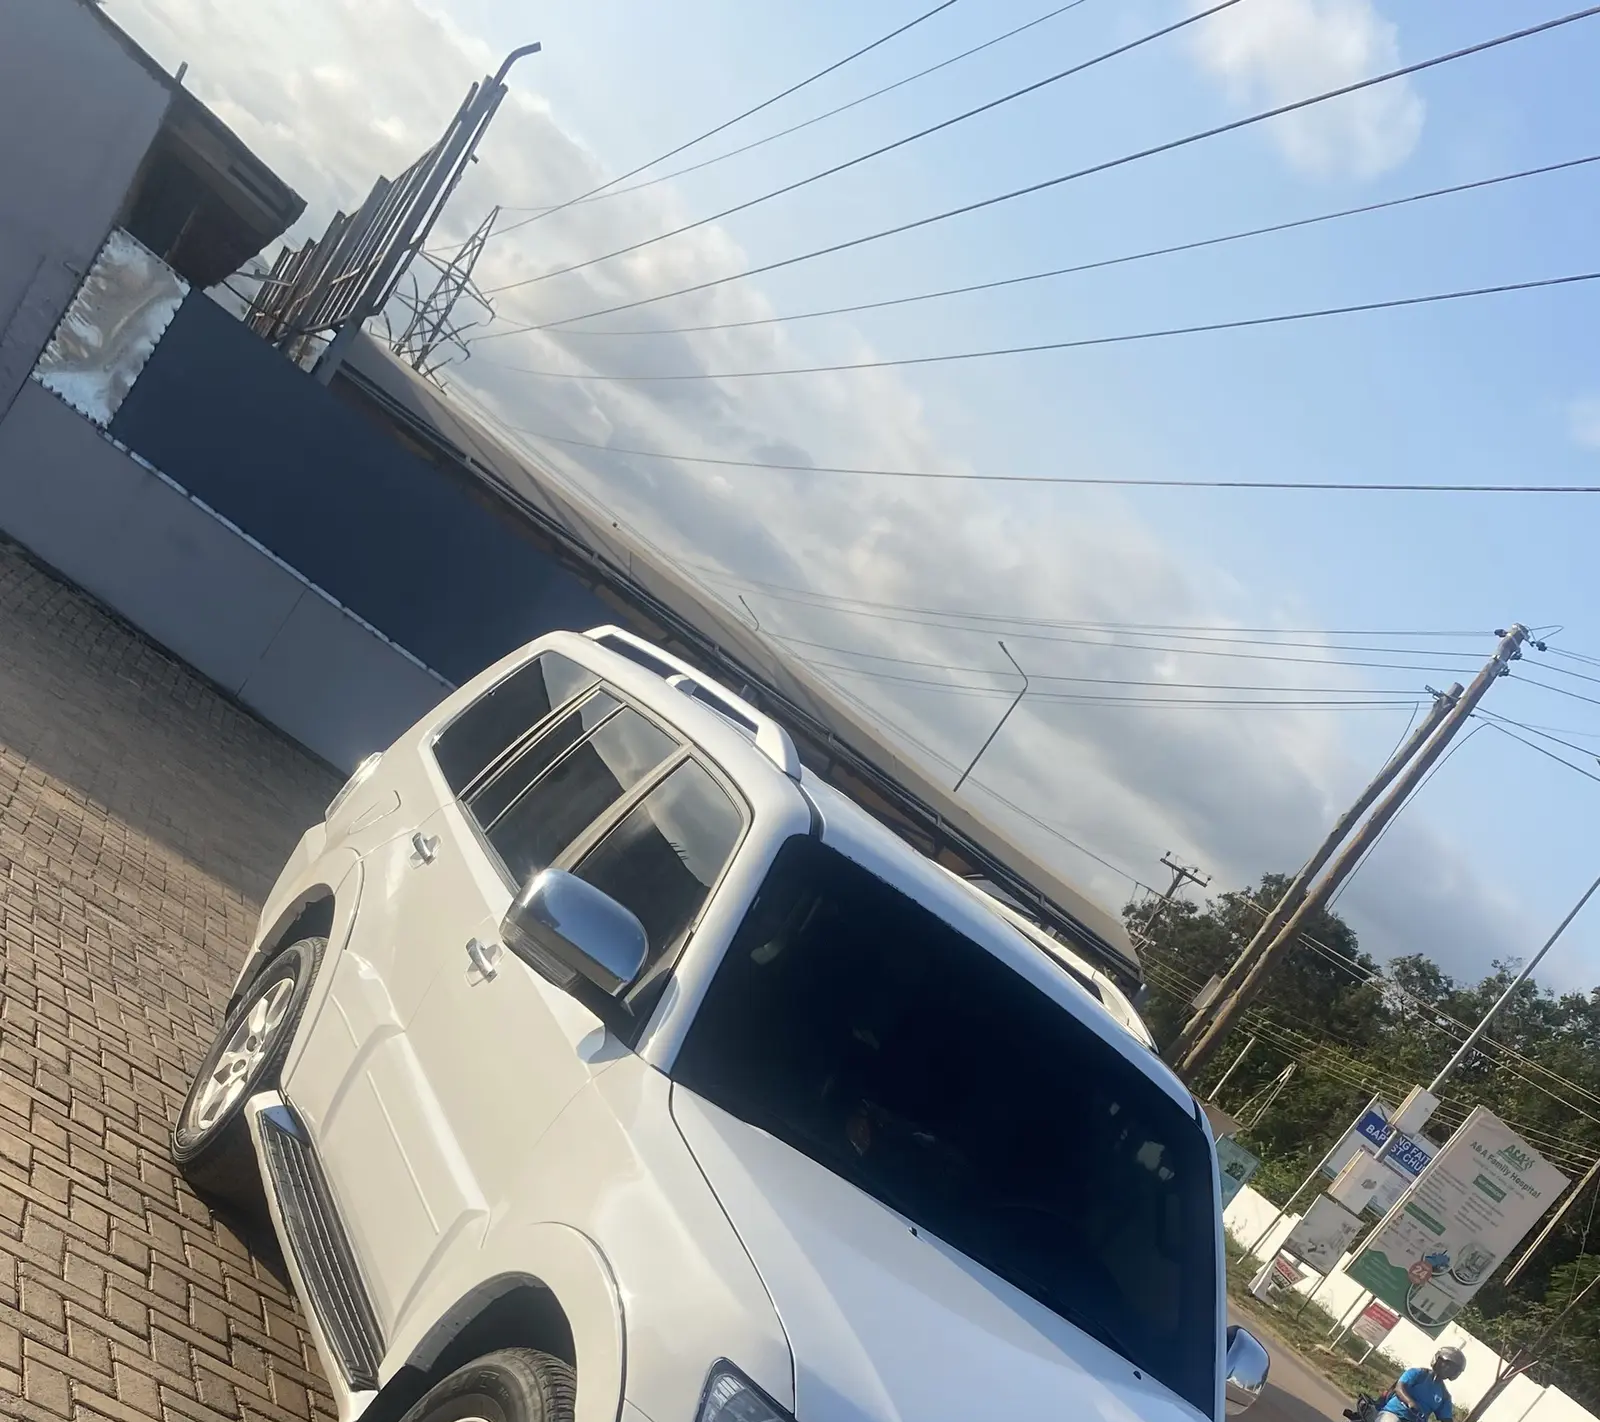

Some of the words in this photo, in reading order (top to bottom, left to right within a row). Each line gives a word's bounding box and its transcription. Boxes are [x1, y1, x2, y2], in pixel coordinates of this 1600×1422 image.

[1365, 1124, 1405, 1159] BAPST
[1381, 1125, 1411, 1151] LING
[1410, 1146, 1432, 1165] FAIT
[1470, 1141, 1488, 1157] A&A
[1487, 1154, 1511, 1176] Family
[1510, 1172, 1542, 1199] Hospital
[1411, 1265, 1428, 1278] 24
